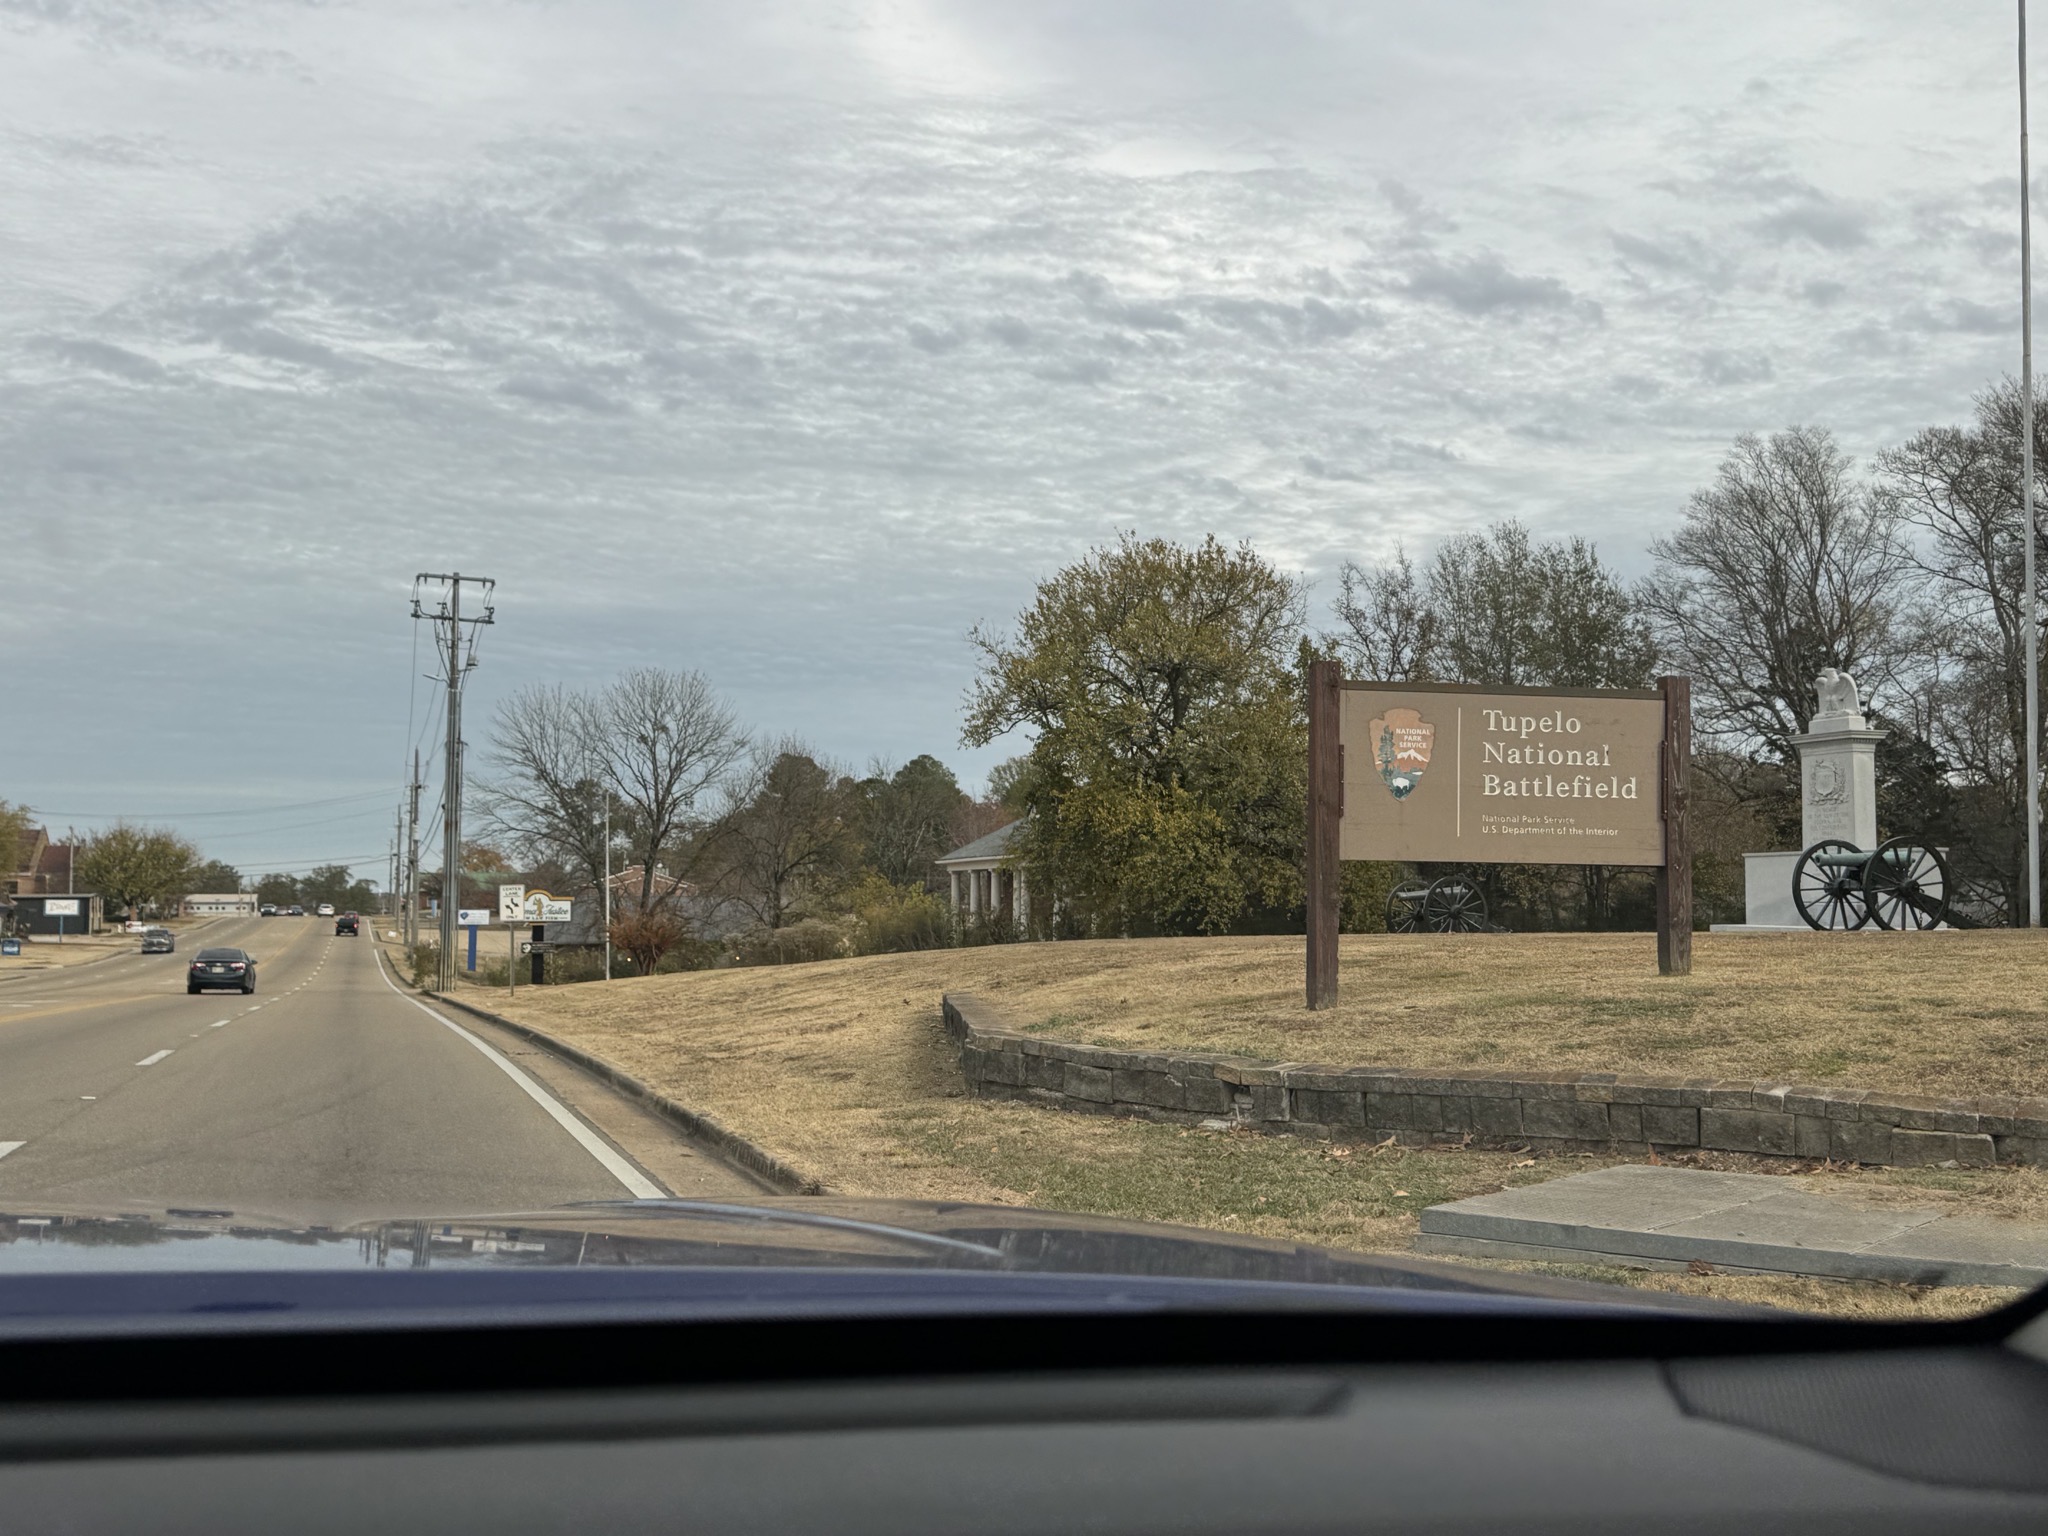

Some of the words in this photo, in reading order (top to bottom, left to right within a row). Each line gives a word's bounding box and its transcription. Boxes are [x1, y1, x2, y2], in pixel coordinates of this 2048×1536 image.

[1483, 709, 1581, 738] Tupelo
[1483, 742, 1611, 766] National
[1483, 774, 1638, 799] Battlefield
[1482, 815, 1520, 823] National
[1522, 815, 1541, 823] Park
[1544, 816, 1575, 824] Service
[1482, 825, 1499, 833] U.S.
[1502, 826, 1555, 835] Department
[1557, 826, 1567, 834] of
[1569, 827, 1583, 835] the
[1586, 827, 1619, 836] Interior
